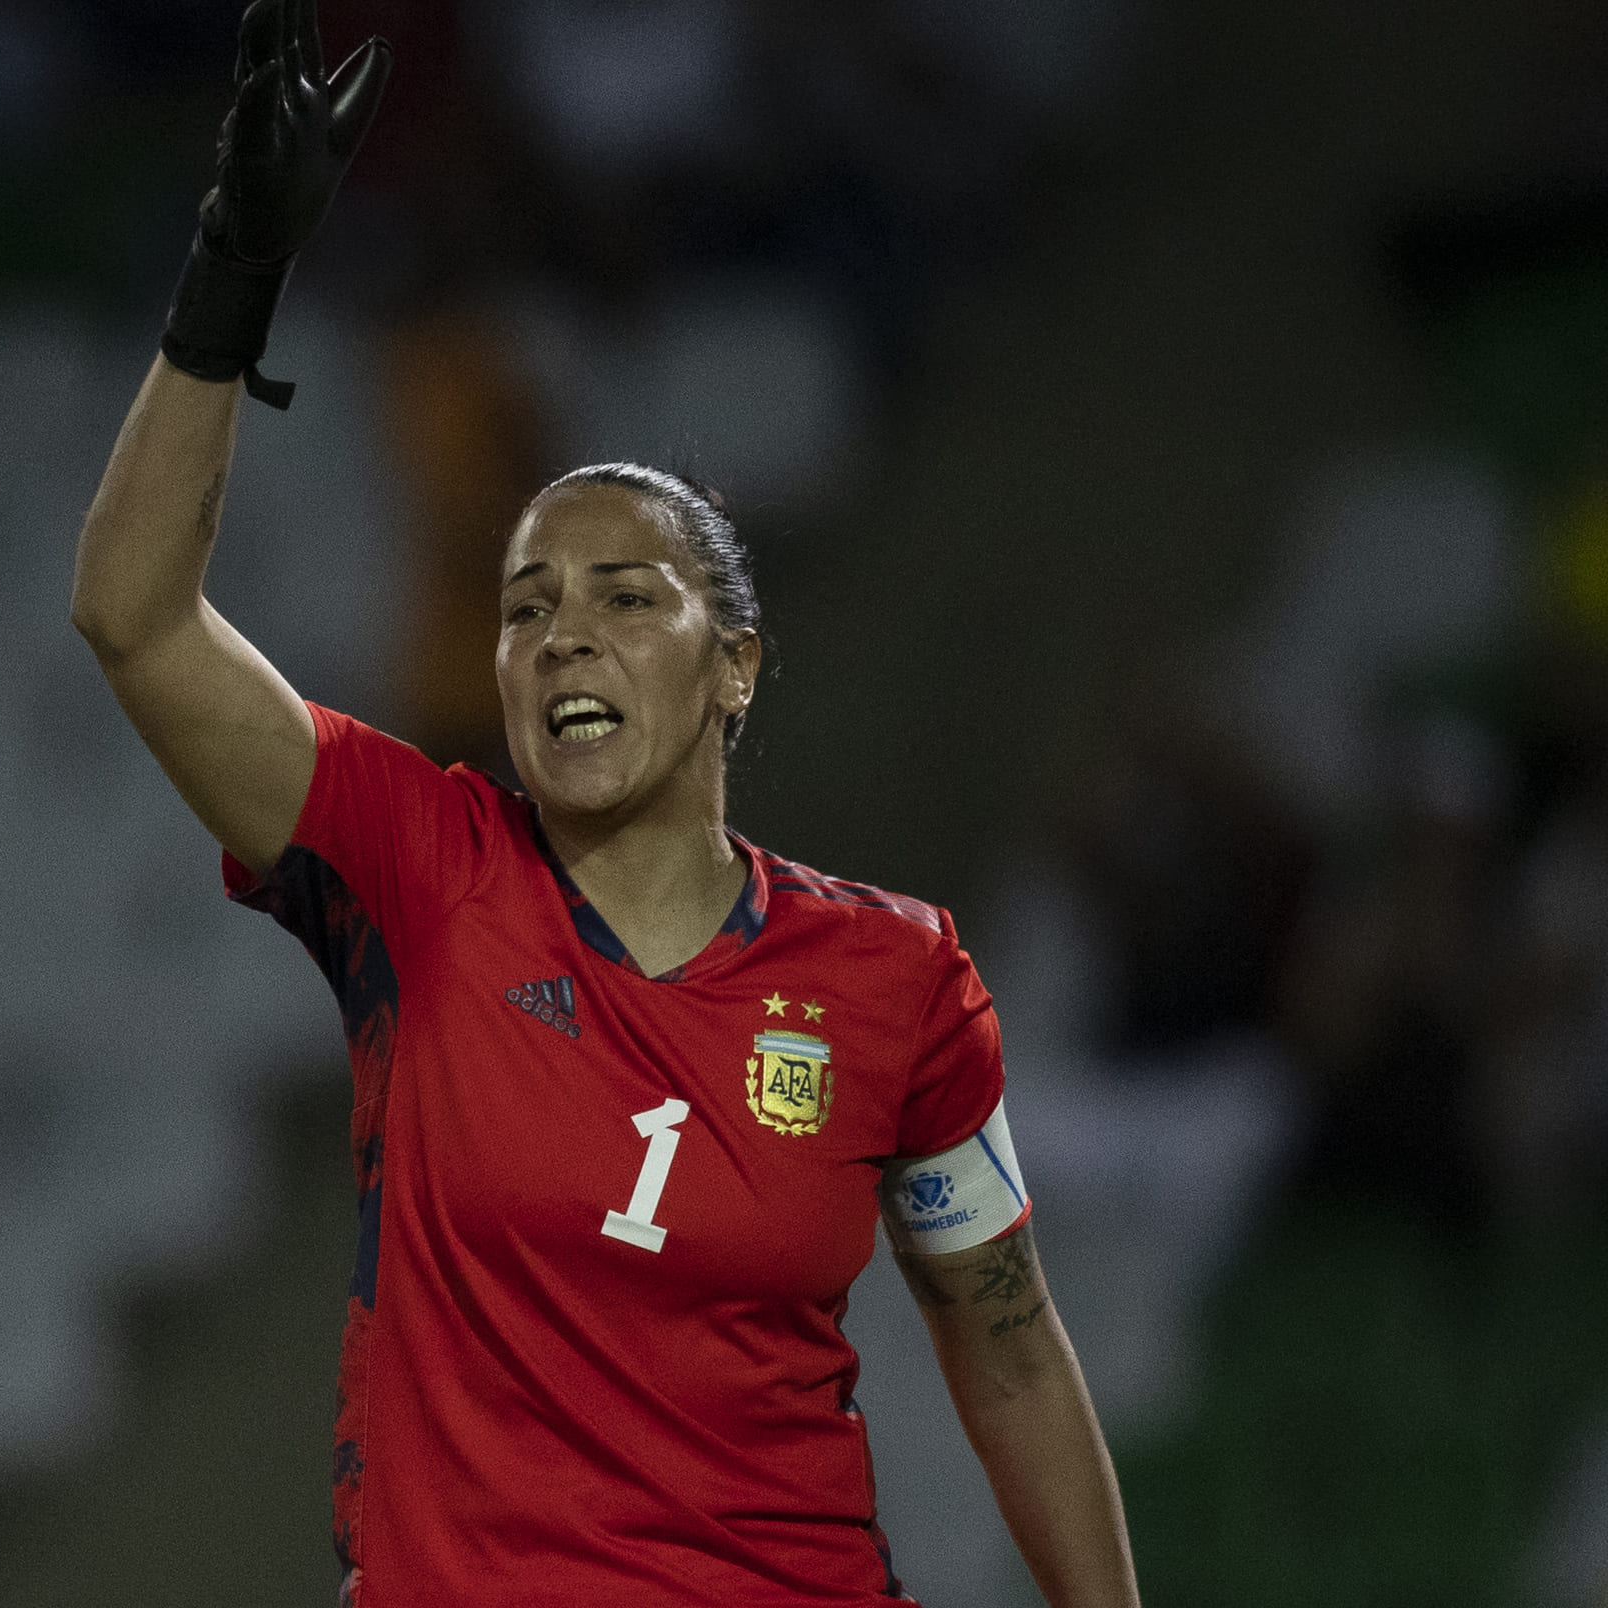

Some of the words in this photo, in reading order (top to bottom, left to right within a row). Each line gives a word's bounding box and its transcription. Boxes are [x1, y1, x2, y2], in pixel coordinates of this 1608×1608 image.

[505, 988, 581, 1038] adidas
[768, 1056, 815, 1107] AFA
[601, 1098, 690, 1253] 1
